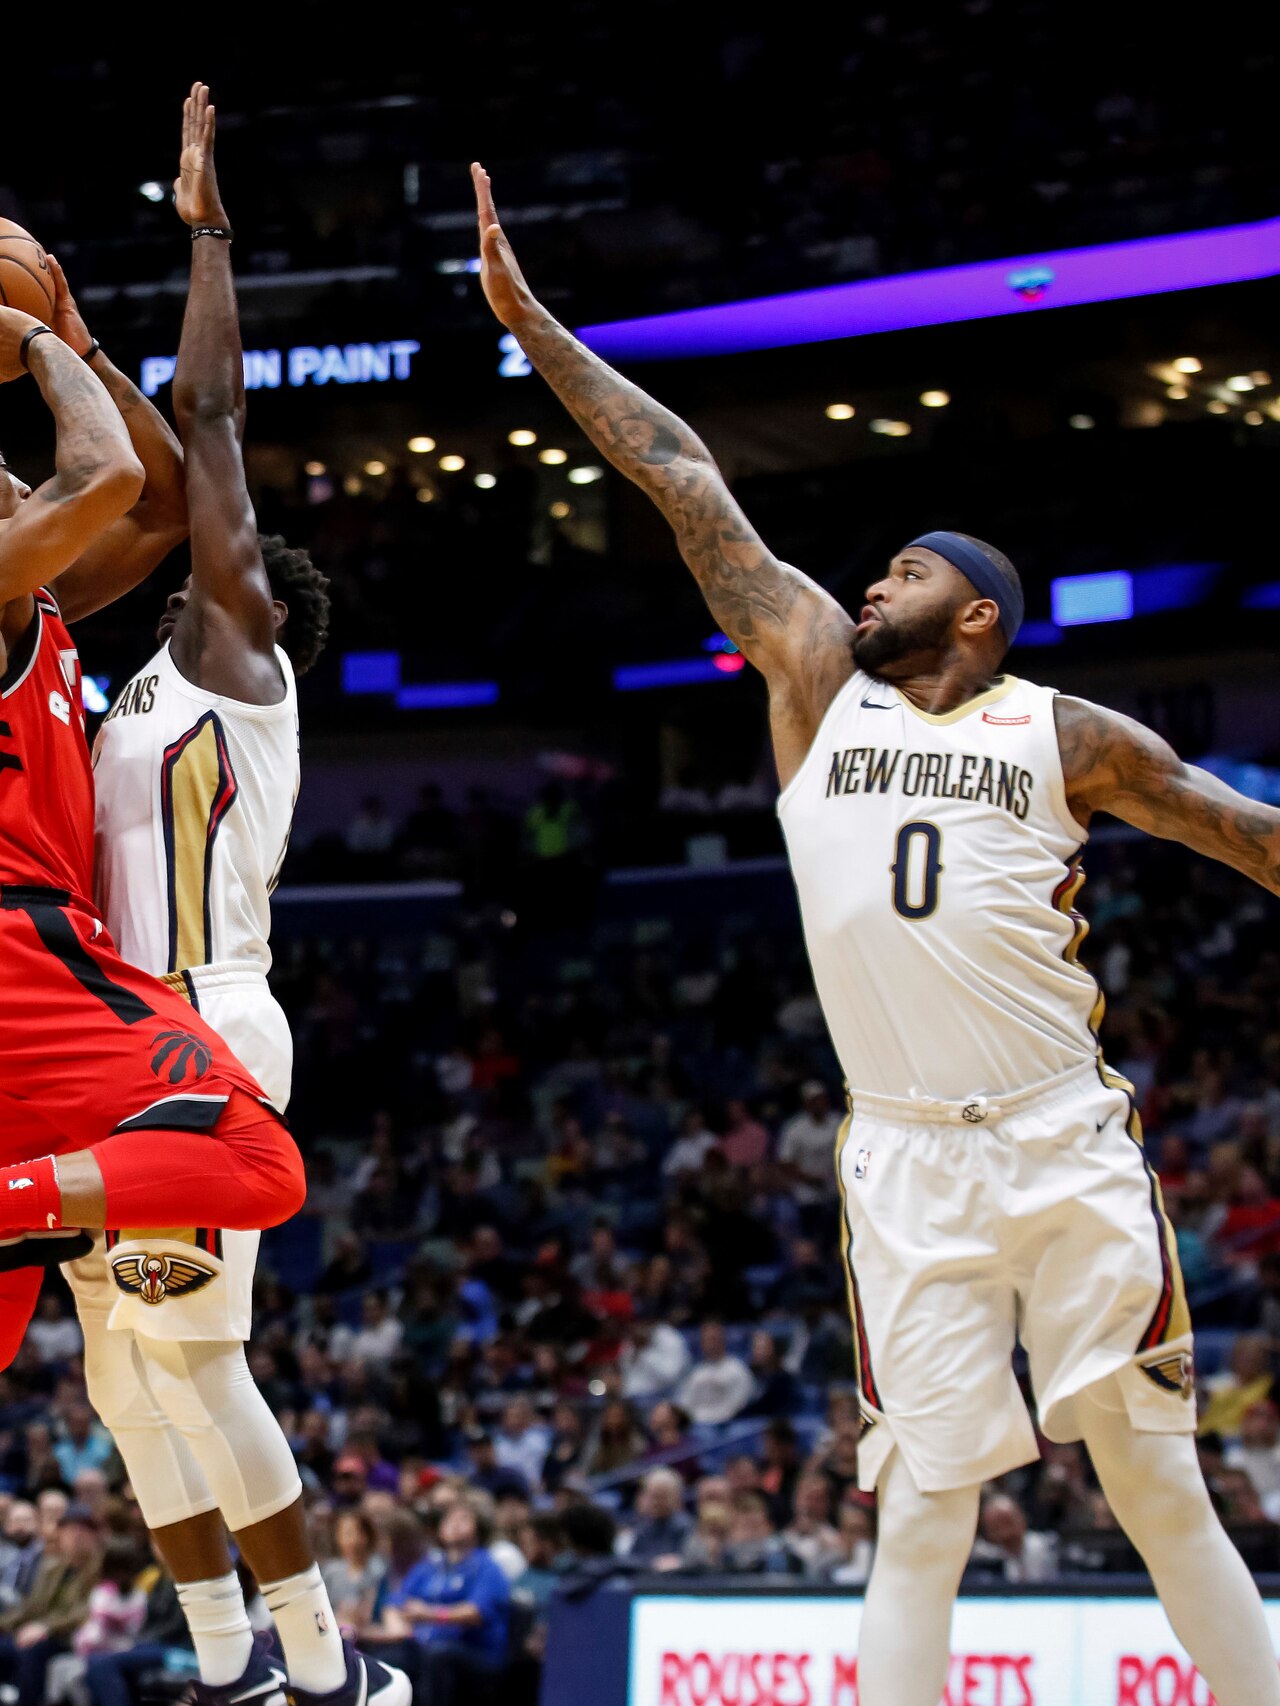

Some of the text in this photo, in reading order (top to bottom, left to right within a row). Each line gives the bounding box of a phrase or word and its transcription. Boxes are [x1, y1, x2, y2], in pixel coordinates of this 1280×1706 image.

[288, 339, 421, 387] PAINT
[826, 748, 1034, 821] NEW ORLEANS
[889, 818, 946, 922] 0
[661, 1651, 812, 1706] ROUSES
